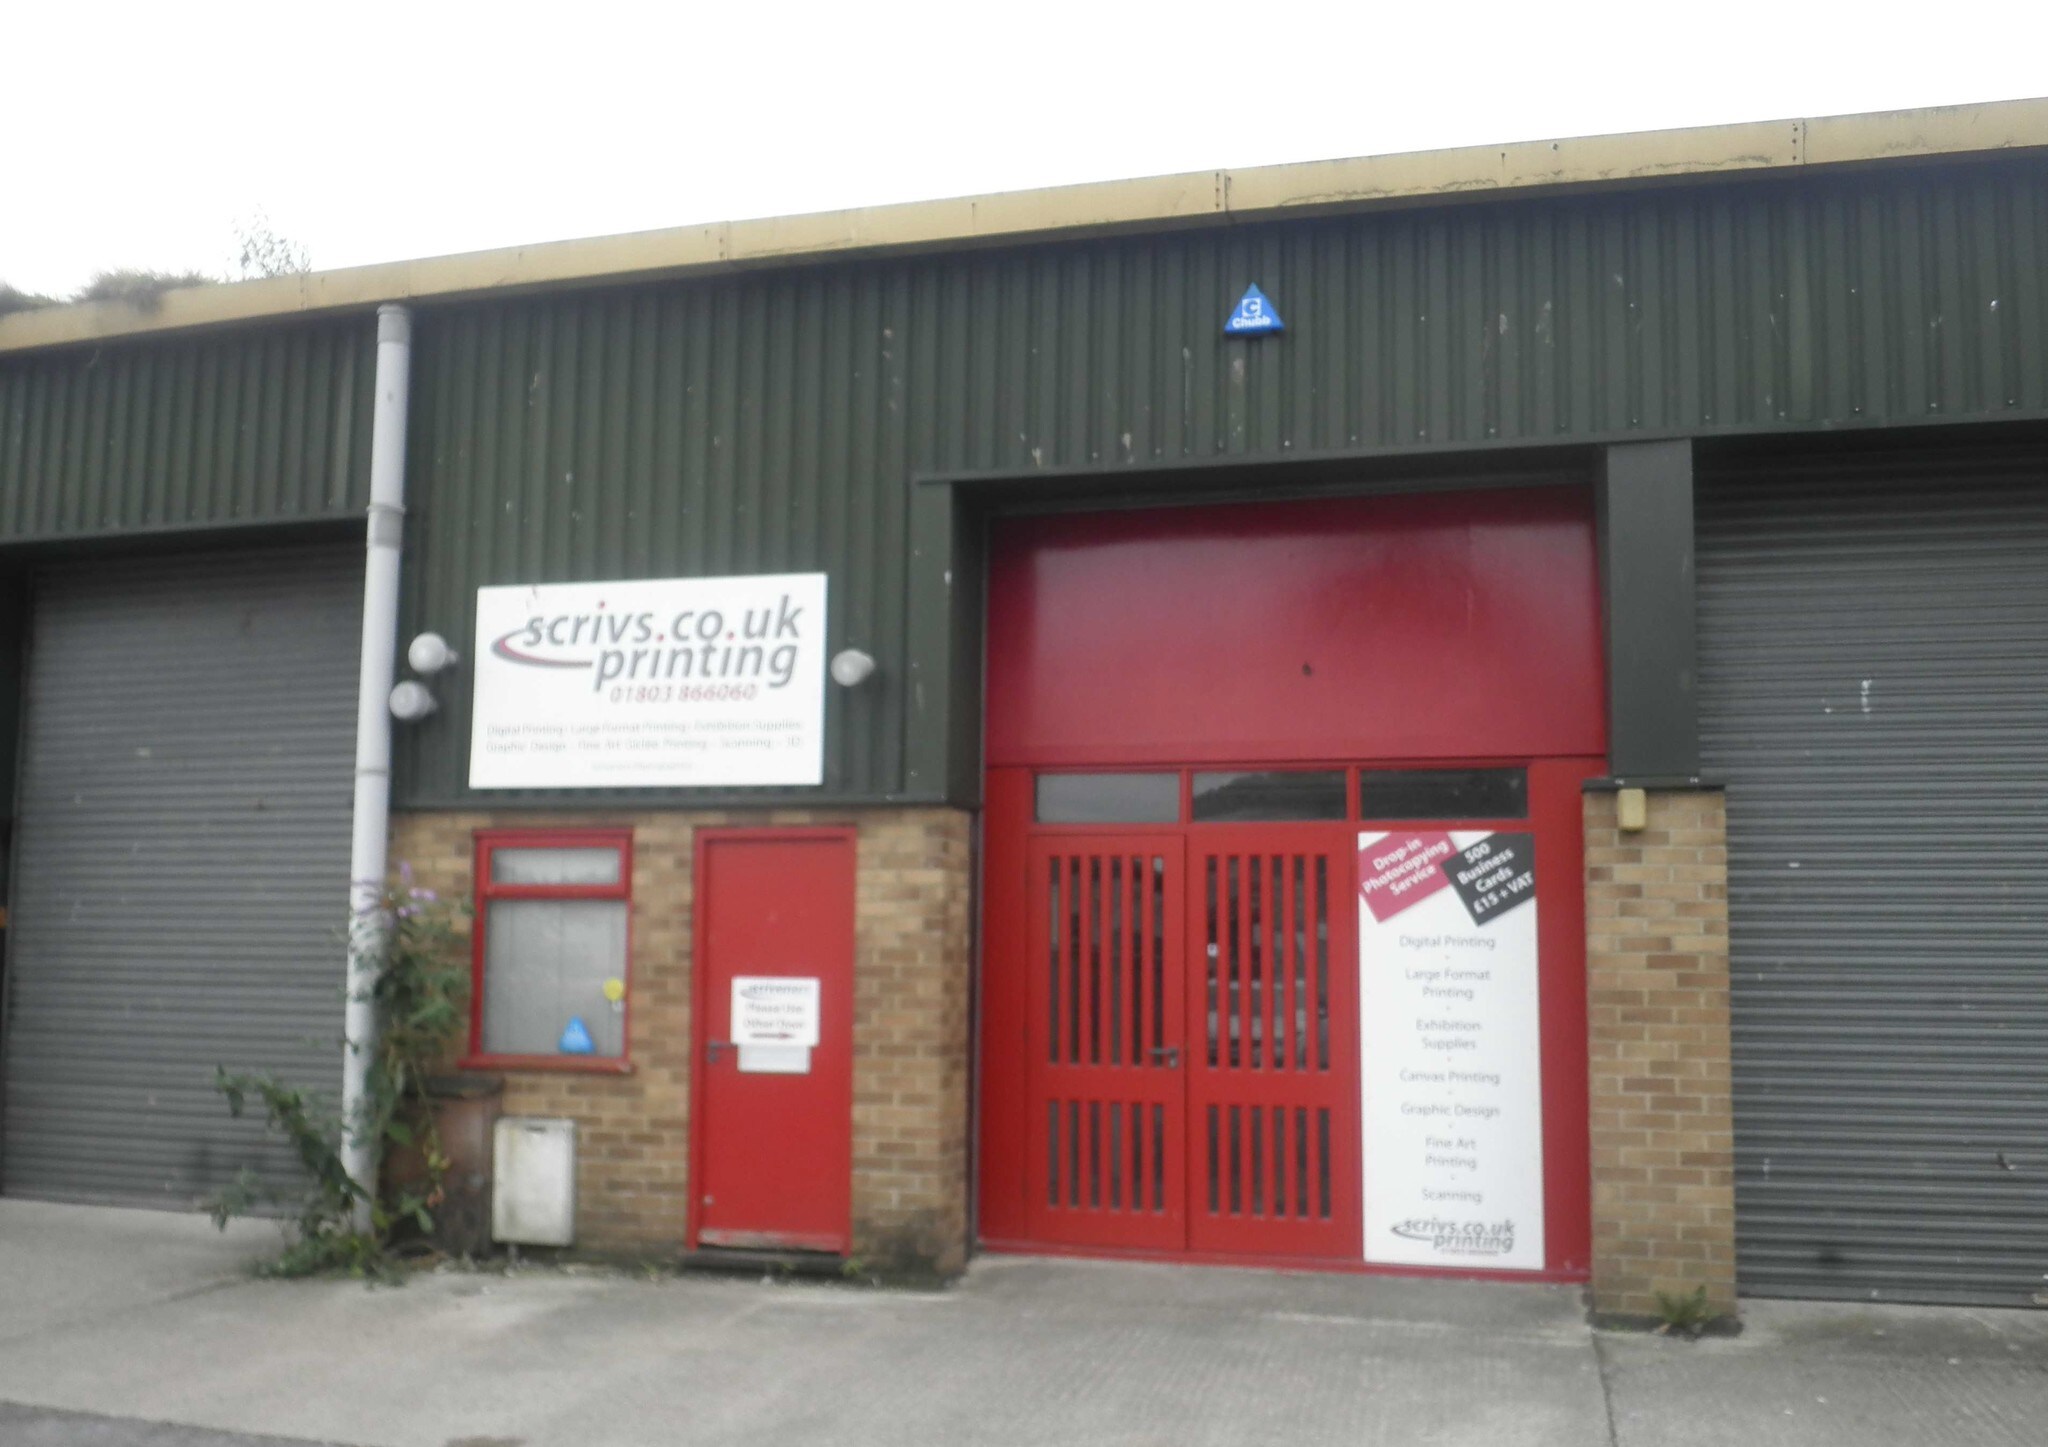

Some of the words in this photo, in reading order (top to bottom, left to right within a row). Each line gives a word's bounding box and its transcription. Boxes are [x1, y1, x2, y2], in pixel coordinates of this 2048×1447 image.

[523, 594, 803, 647] scrivs.co.uk
[594, 640, 798, 691] printing
[610, 685, 671, 704] 01803
[522, 722, 564, 736] Printing
[641, 720, 688, 734] Printing
[754, 718, 802, 732] Supplies
[1372, 837, 1423, 871] Drop-in
[1464, 842, 1491, 864] 500
[1362, 840, 1450, 894] Photocopying
[1456, 847, 1515, 885] Business
[1389, 864, 1436, 896] Service
[1475, 866, 1514, 893] Cards
[1473, 892, 1500, 914] £15
[1506, 871, 1534, 893] VAT
[1399, 935, 1441, 949] Digital
[1444, 935, 1496, 950] Printing
[1406, 968, 1441, 982] Large
[1444, 967, 1491, 981] Format
[1422, 986, 1474, 1001] Printing
[1416, 1018, 1481, 1032] Exhibition
[1422, 1037, 1476, 1050] Supplies
[1399, 1069, 1445, 1083] Canvas
[1449, 1070, 1500, 1086] Printing
[1400, 1102, 1450, 1118] Graphic
[1454, 1103, 1501, 1119] Design
[1425, 1137, 1452, 1149] Fine
[1456, 1137, 1477, 1149] Art
[1425, 1155, 1477, 1171] Printing
[1422, 1188, 1482, 1205] Scanning
[1403, 1217, 1515, 1237] scrivs.co.uk
[1433, 1233, 1515, 1253] printing
